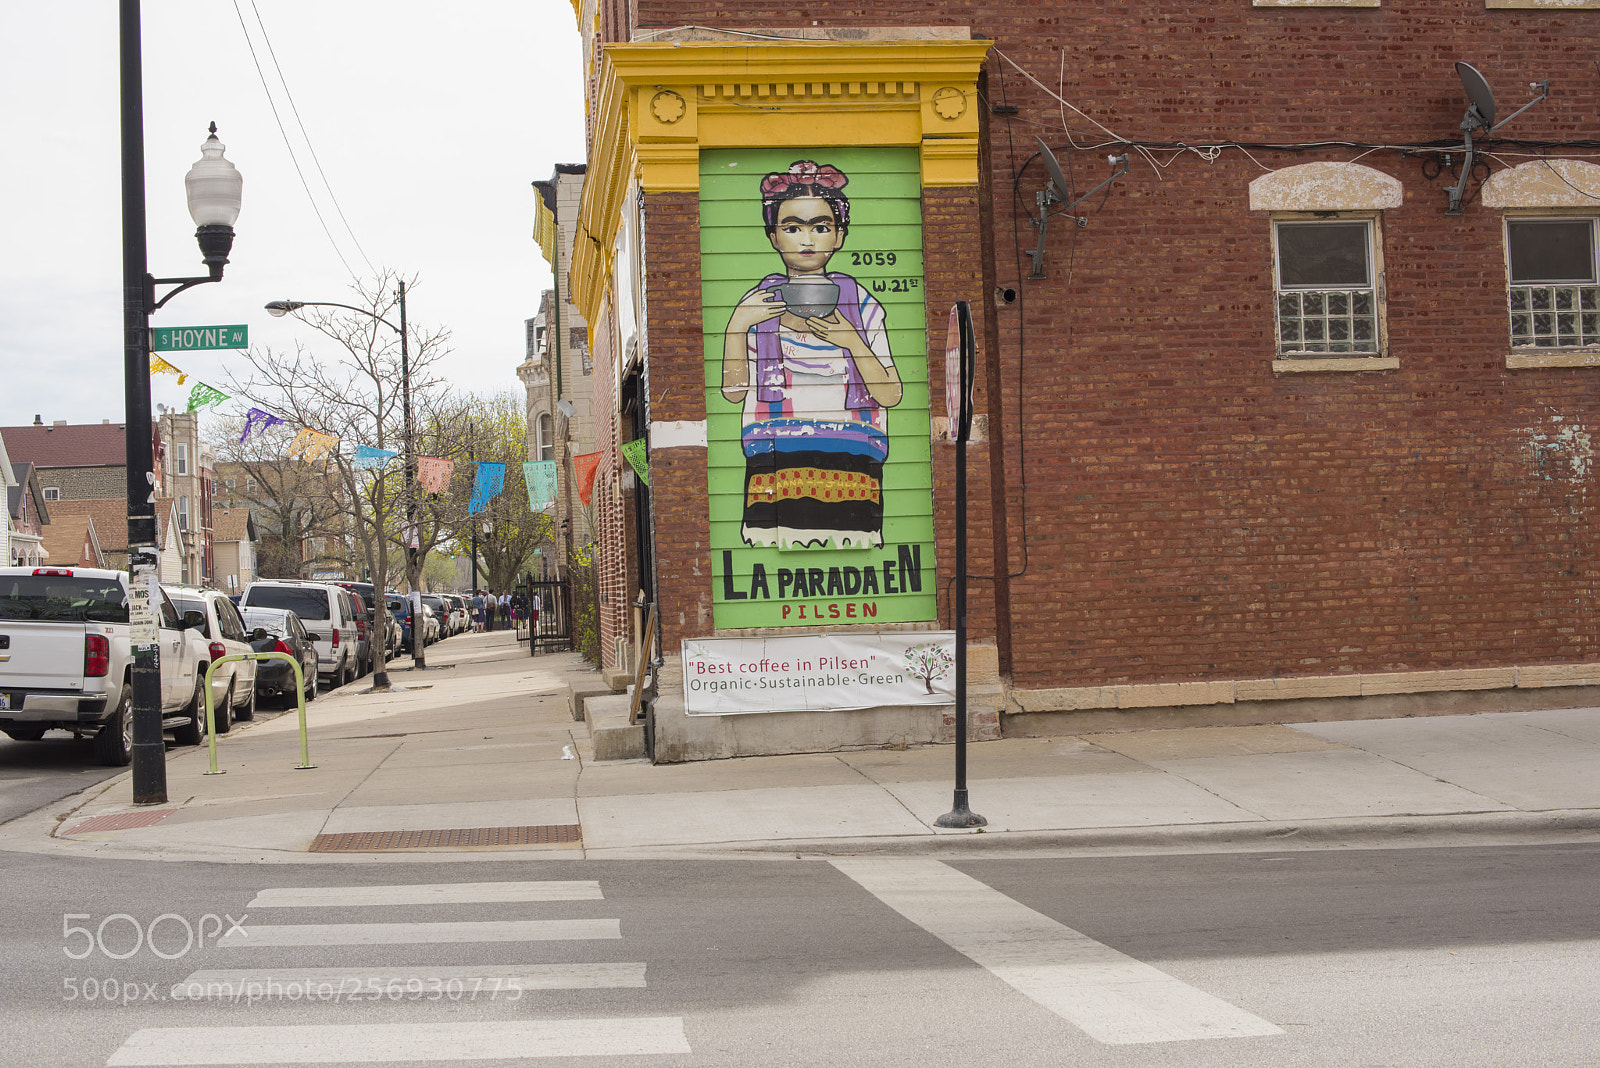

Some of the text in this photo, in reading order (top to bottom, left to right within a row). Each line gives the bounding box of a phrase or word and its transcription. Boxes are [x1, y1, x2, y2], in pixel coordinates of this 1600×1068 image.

[851, 252, 897, 266] 2059
[162, 328, 243, 348] S HOYNE AV
[722, 544, 922, 601] LA PARADA EN
[782, 601, 878, 620] PILSEN
[739, 659, 790, 673] coffee
[797, 658, 812, 672] in
